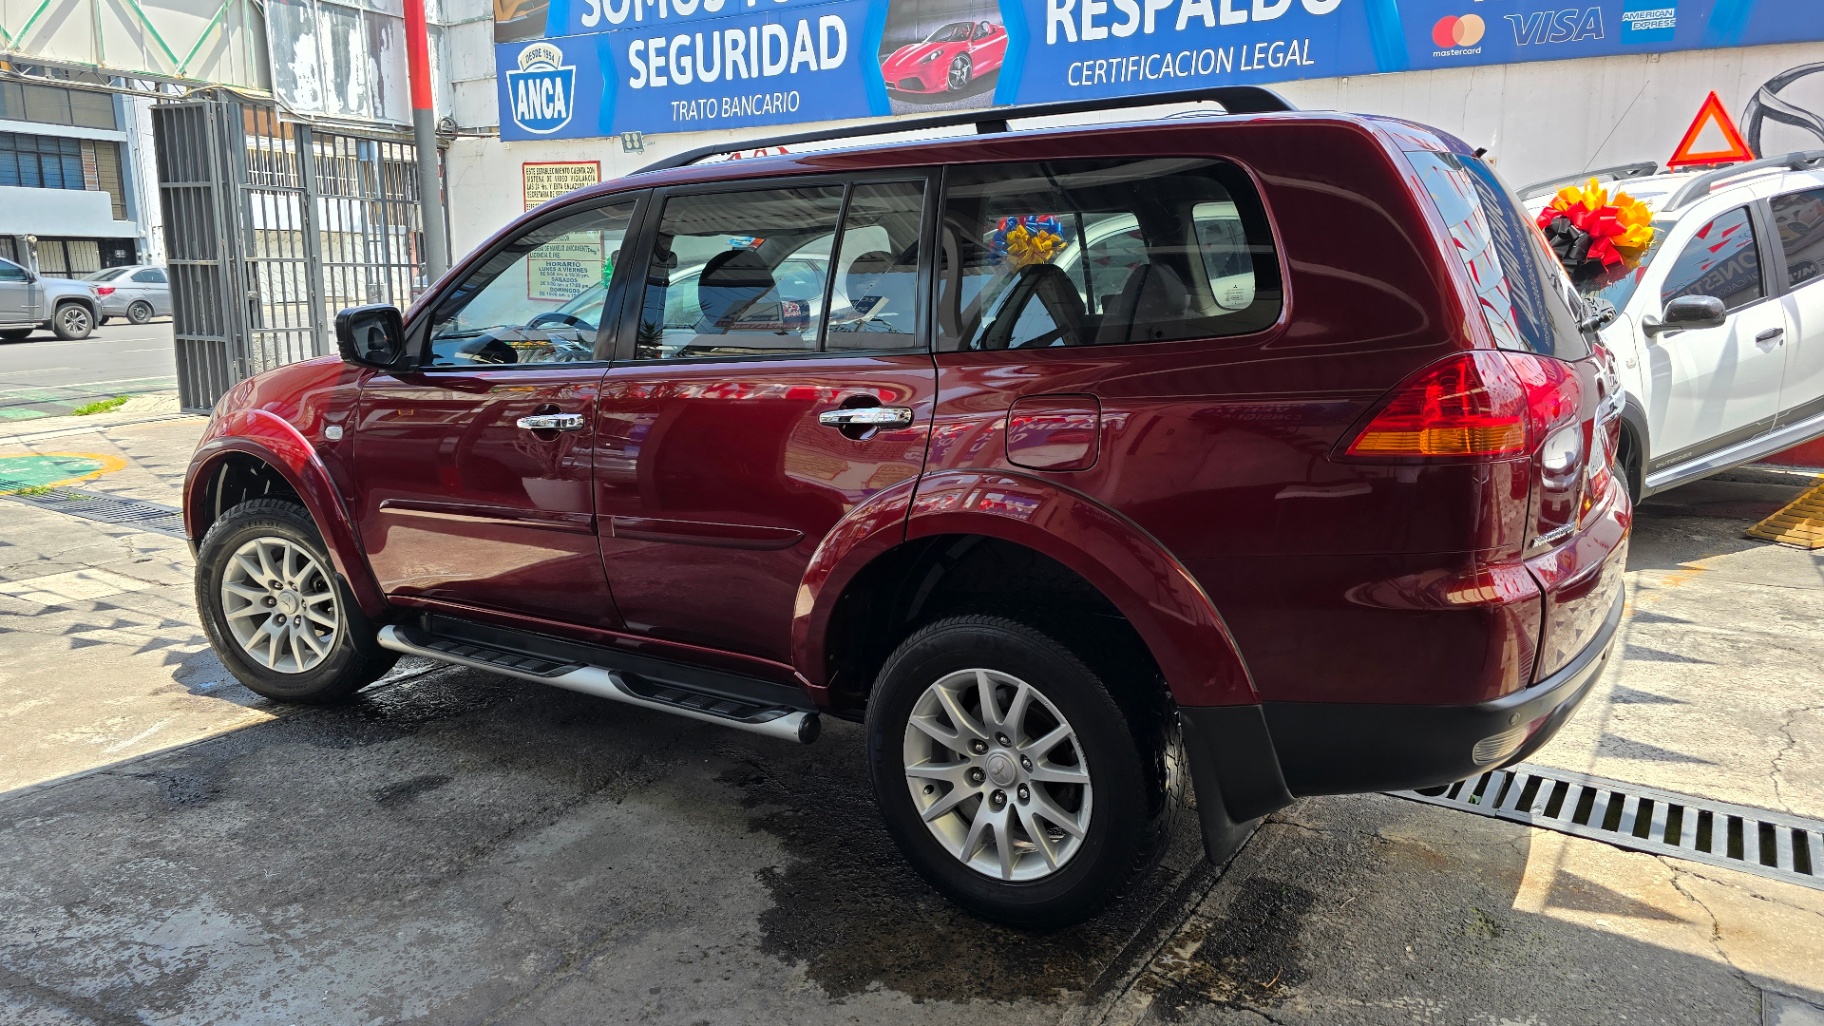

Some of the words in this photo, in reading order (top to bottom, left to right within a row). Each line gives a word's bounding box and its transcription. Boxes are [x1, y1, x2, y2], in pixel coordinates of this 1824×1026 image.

[1046, 0, 1341, 45] RESPA
[1503, 6, 1605, 46] VISA
[1622, 9, 1674, 21] AMERICAN
[1632, 19, 1676, 30] EXPRESS
[525, 48, 542, 64] DESDE
[542, 49, 556, 64] 1954
[628, 14, 848, 89] SEGURIDAD
[1068, 47, 1234, 87] CERTIFICACION
[1240, 38, 1315, 71] LEGAL
[1432, 46, 1482, 58] mastercard
[517, 77, 567, 120] ANCA
[671, 98, 718, 121] TRATO
[721, 90, 800, 118] BANCARIO
[526, 167, 536, 175] ESTE
[570, 167, 586, 175] CUENTA
